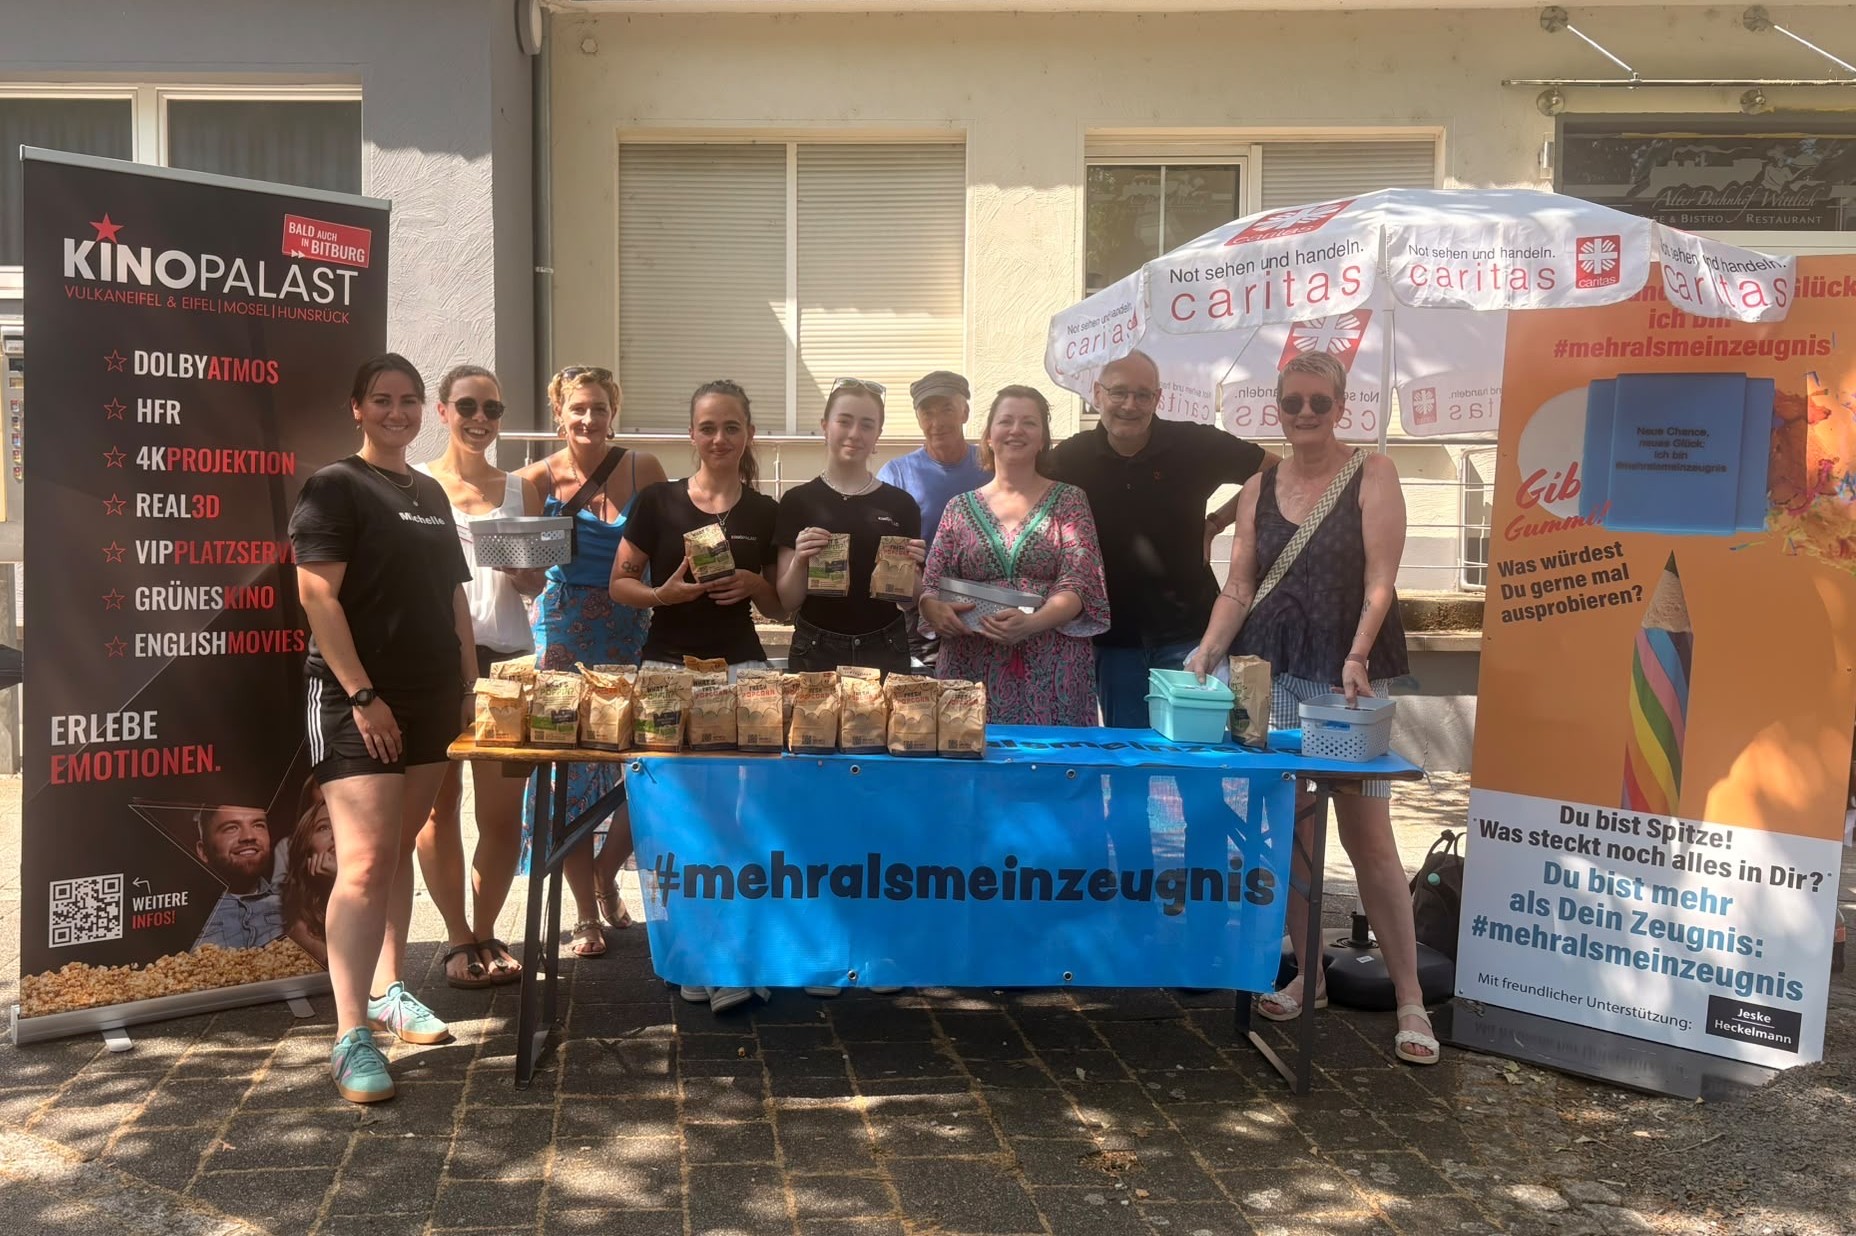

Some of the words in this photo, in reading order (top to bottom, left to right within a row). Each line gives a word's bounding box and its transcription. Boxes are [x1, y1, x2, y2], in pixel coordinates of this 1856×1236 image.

[1652, 188, 1696, 208] Alter
[1696, 185, 1762, 224] Bahnhof
[1680, 213, 1724, 224] BISTRO
[1746, 213, 1822, 225] RESTAURANT
[289, 221, 315, 237] BALD
[317, 230, 337, 242] AUCH
[301, 238, 309, 247] IN
[311, 240, 365, 263] BITBURG
[1170, 267, 1199, 283] Not
[1205, 262, 1255, 281] sehen
[1261, 251, 1289, 270] und
[1296, 239, 1364, 265] handeln.
[1408, 244, 1429, 257] Not
[1432, 247, 1469, 259] sehen
[1472, 247, 1495, 260] und
[1500, 246, 1556, 259] handeln.
[1721, 258, 1787, 273] handeln.
[63, 237, 359, 307] KINOPALAST
[1409, 262, 1556, 291] caritas
[1578, 275, 1617, 288] caritas
[1793, 275, 1856, 297] lück
[64, 285, 162, 308] VULKANEIFEL
[166, 296, 177, 308] &
[1170, 265, 1361, 322] caritas
[1648, 308, 1685, 329] ich
[1553, 333, 1831, 362] #mehralsmeinzeugnis
[134, 350, 280, 385] DOLBYATMOS
[137, 398, 181, 425] HFR
[136, 445, 296, 476] 4KPROJEKTION
[1515, 461, 1582, 509] Gib
[136, 492, 220, 519] REAL3D
[398, 511, 446, 525] Michelle
[1504, 500, 1613, 541] Gummi!
[1497, 560, 1537, 578] Was
[1540, 541, 1624, 570] würdest
[135, 580, 275, 611] GRÜNESKINO
[1501, 583, 1526, 600] Du
[1531, 573, 1588, 599] gerne
[1592, 562, 1630, 586] mal
[1501, 584, 1643, 624] ausprobieren?
[135, 629, 305, 658] ENGLISHMOVIES
[50, 710, 158, 746] ERLEBE
[50, 744, 222, 786] EMOTIONEN.
[1560, 805, 1590, 829] Du
[1596, 810, 1641, 836] bist
[1647, 816, 1733, 850] Spitze!
[1479, 818, 1523, 844] Was
[1529, 828, 1601, 857] steckt
[1607, 841, 1666, 867] noch
[1672, 851, 1732, 878] alles
[1738, 859, 1762, 884] in
[1769, 865, 1824, 893] Dir?
[653, 849, 1276, 917] #mehralsmeinzeugnis
[1543, 860, 1580, 889] Du
[1588, 867, 1644, 901] bist
[1652, 878, 1734, 917] mehr
[132, 892, 189, 912] WEITERE
[132, 910, 176, 929] INFOS!
[1509, 890, 1551, 916] als
[1558, 895, 1623, 931] Dein
[1630, 909, 1765, 958] Zeugnis:
[1471, 914, 1804, 1001] #mehralsmeinzeugnis
[1477, 971, 1499, 988] Mit
[1502, 976, 1583, 1006] freundlicher
[1586, 995, 1692, 1031] Unterstützung:
[1737, 1006, 1772, 1025] Jeske
[1714, 1018, 1793, 1046] Heckelmann
